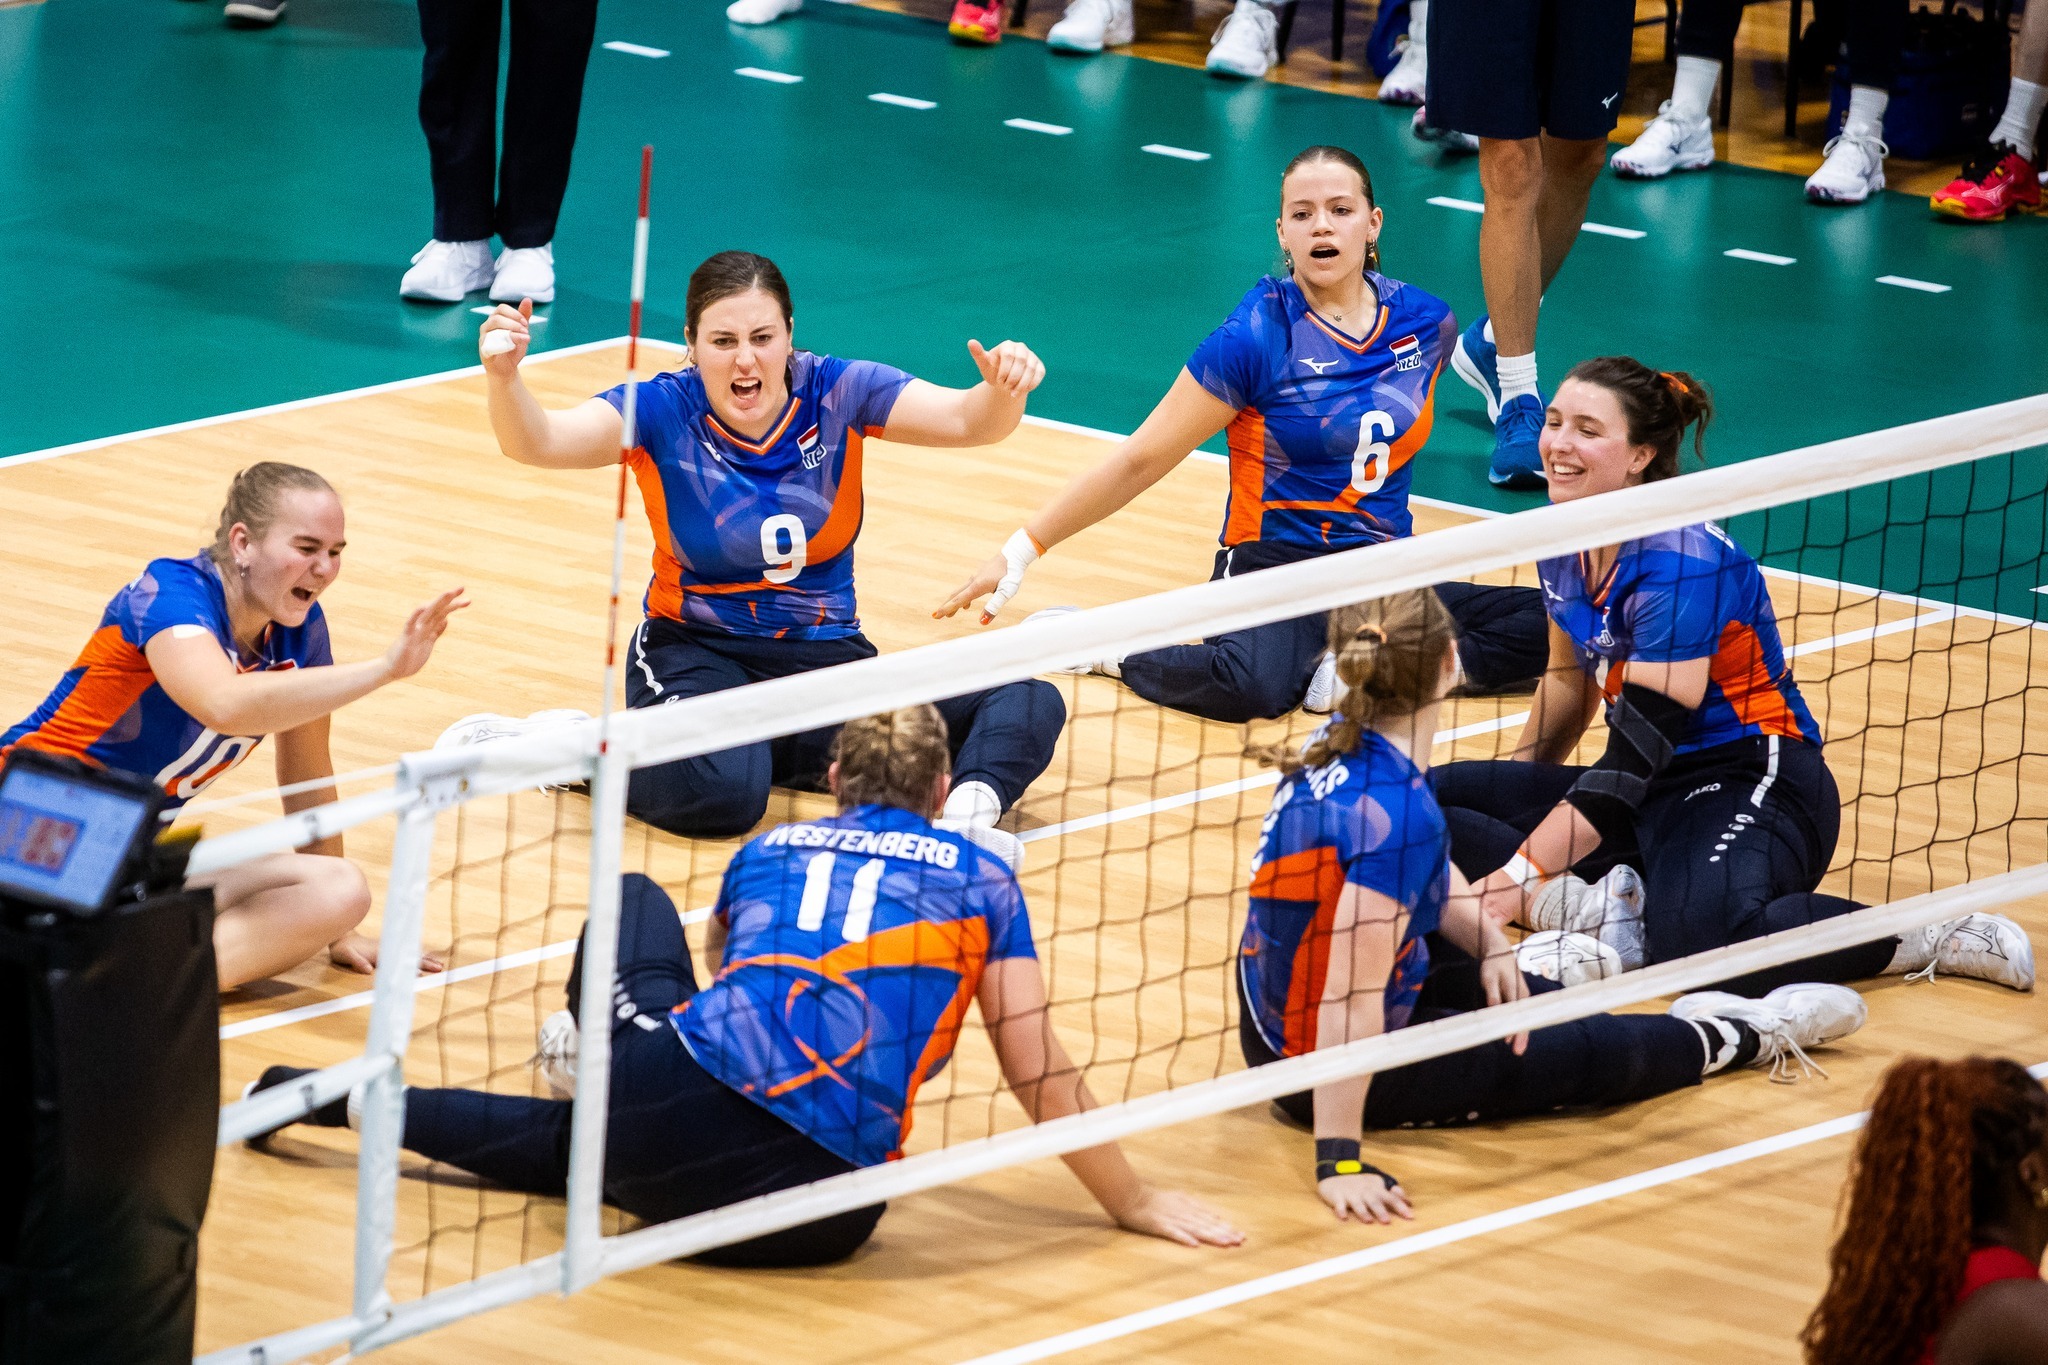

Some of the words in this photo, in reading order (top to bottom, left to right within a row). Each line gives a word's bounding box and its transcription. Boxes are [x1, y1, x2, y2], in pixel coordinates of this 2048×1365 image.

[1350, 410, 1396, 493] 6
[760, 513, 807, 584] 9
[153, 726, 257, 799] 10
[763, 824, 960, 869] WESTENBERG
[796, 851, 886, 943] 11
